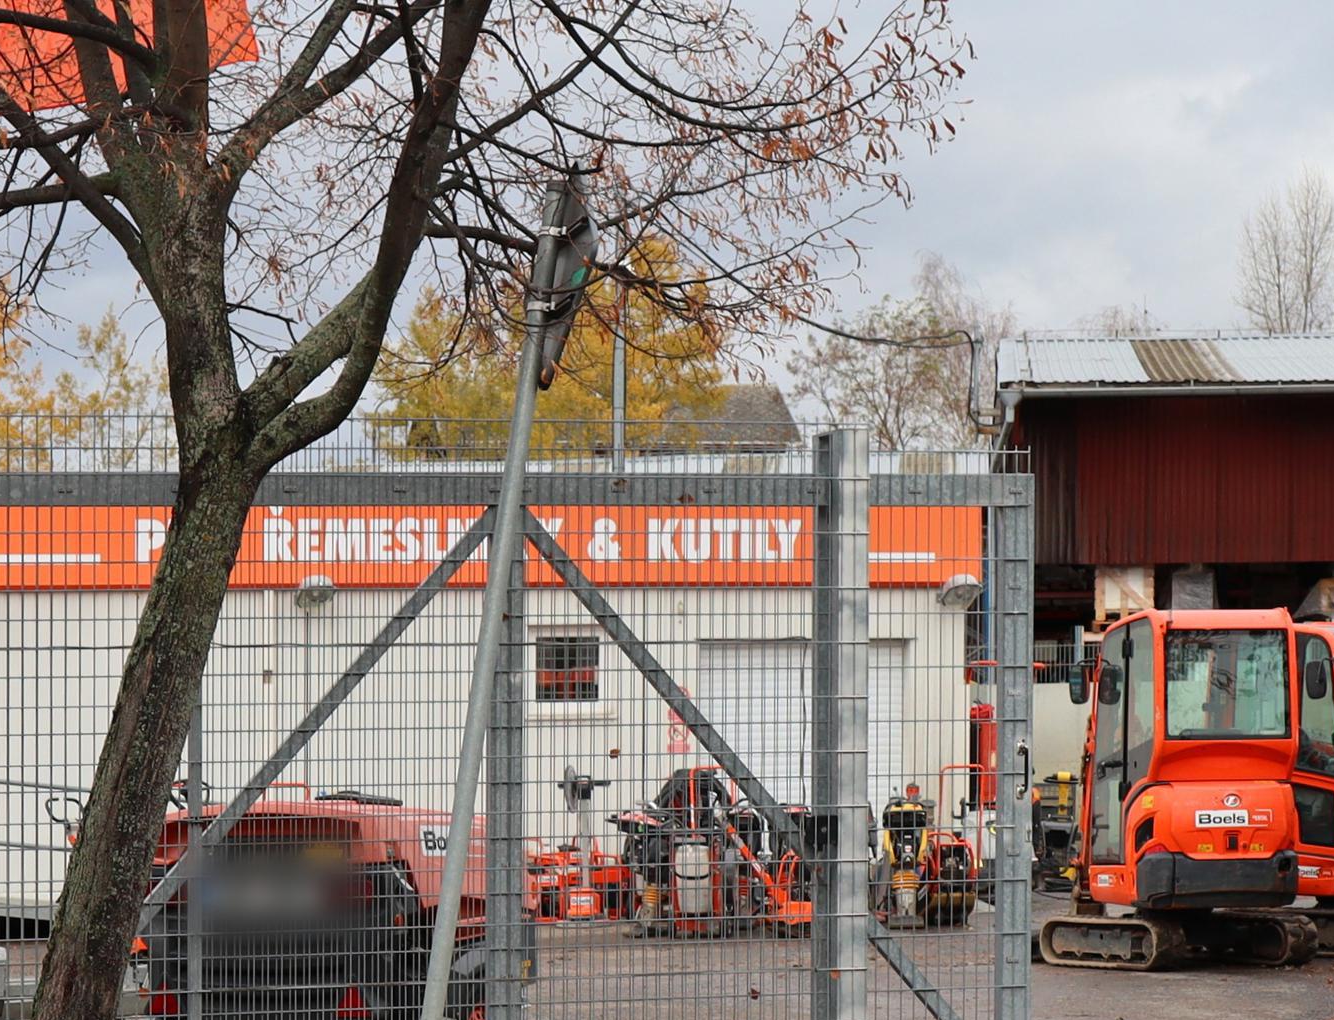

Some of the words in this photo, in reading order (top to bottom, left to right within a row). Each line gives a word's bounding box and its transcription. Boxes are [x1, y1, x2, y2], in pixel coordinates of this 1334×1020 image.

[263, 506, 564, 565] ŘEMESLNY
[587, 518, 620, 564] &
[647, 518, 801, 564] KUTILY
[1198, 813, 1246, 824] Boels
